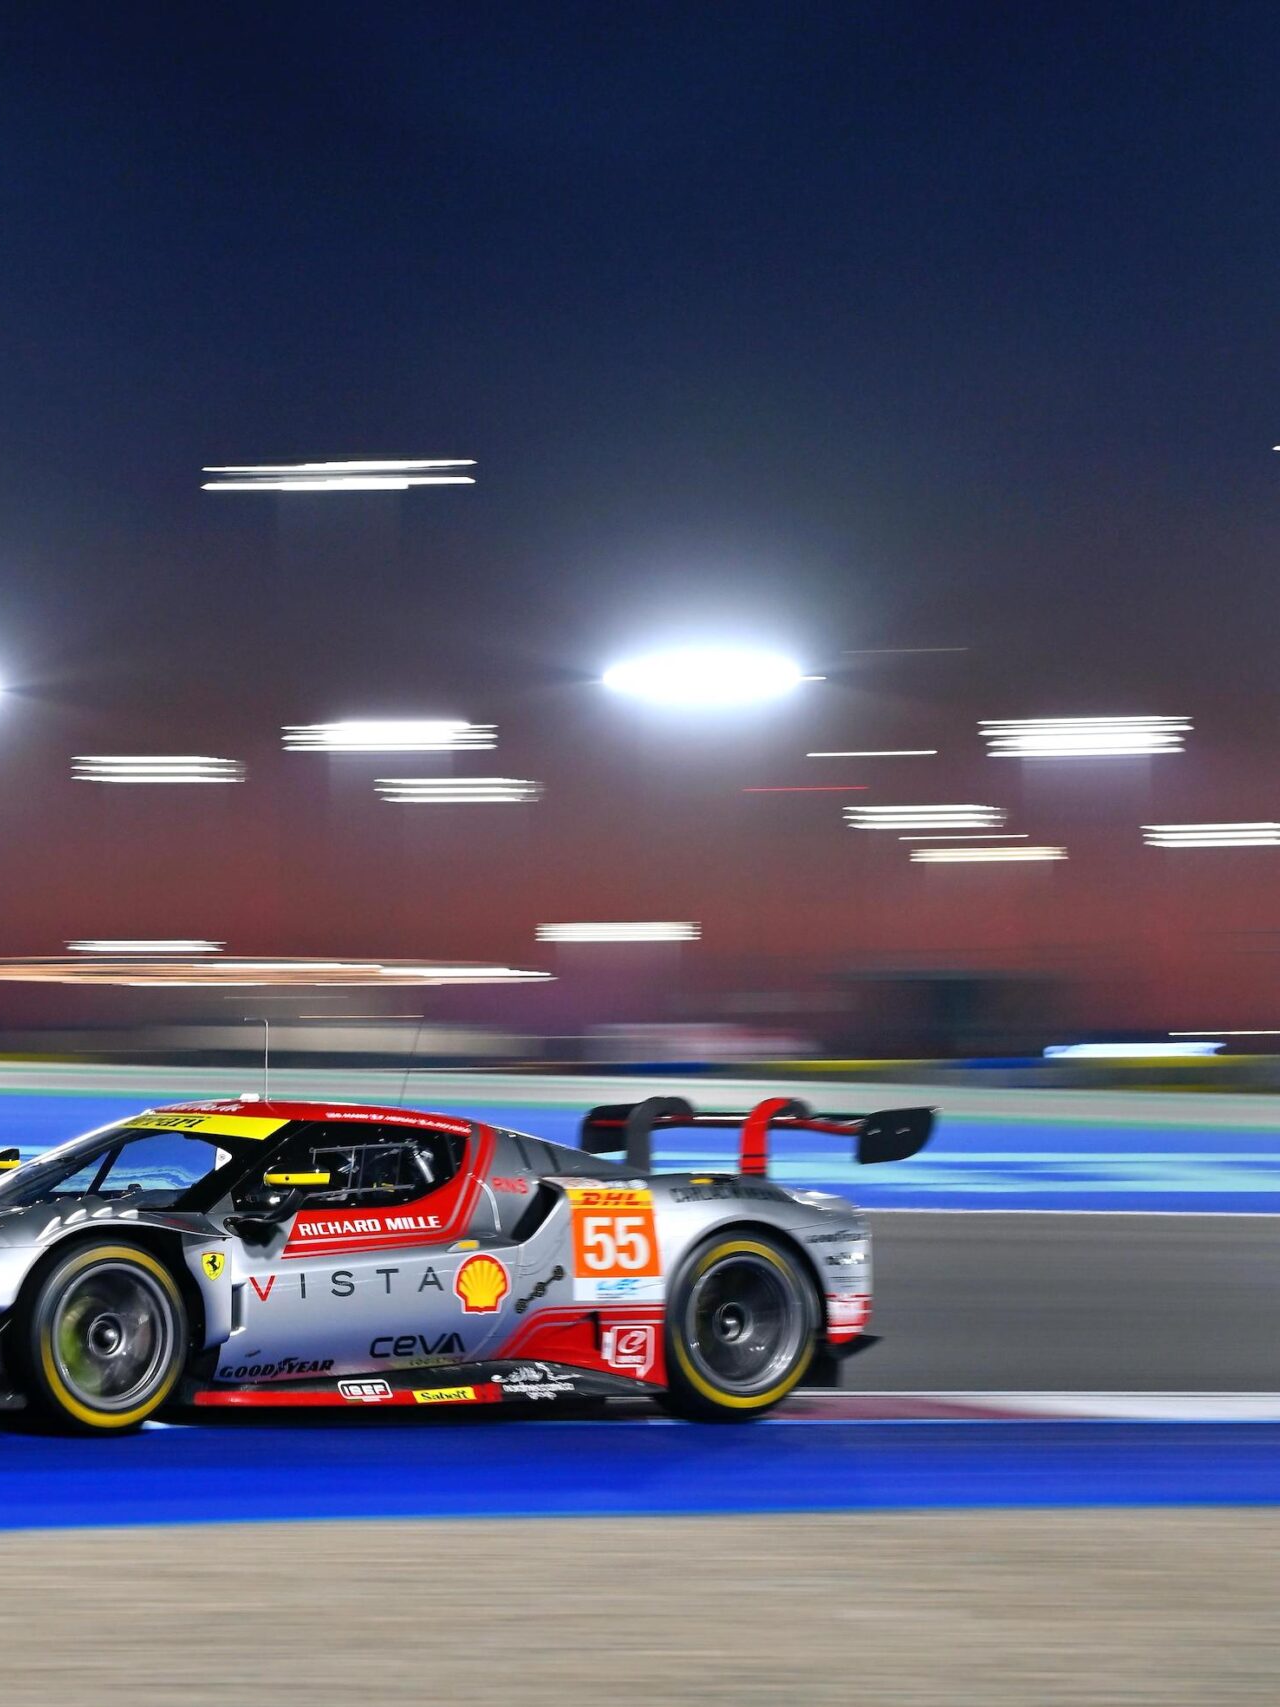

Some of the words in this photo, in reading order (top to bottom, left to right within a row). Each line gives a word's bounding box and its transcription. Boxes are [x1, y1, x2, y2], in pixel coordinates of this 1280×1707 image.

[581, 1192, 640, 1206] DHL
[298, 1218, 381, 1237] RICHARD
[385, 1215, 442, 1232] MILLE
[583, 1216, 650, 1270] 55
[249, 1266, 445, 1302] VISTA
[220, 1357, 335, 1379] GOODYEAR
[420, 1389, 468, 1401] Sabelt
